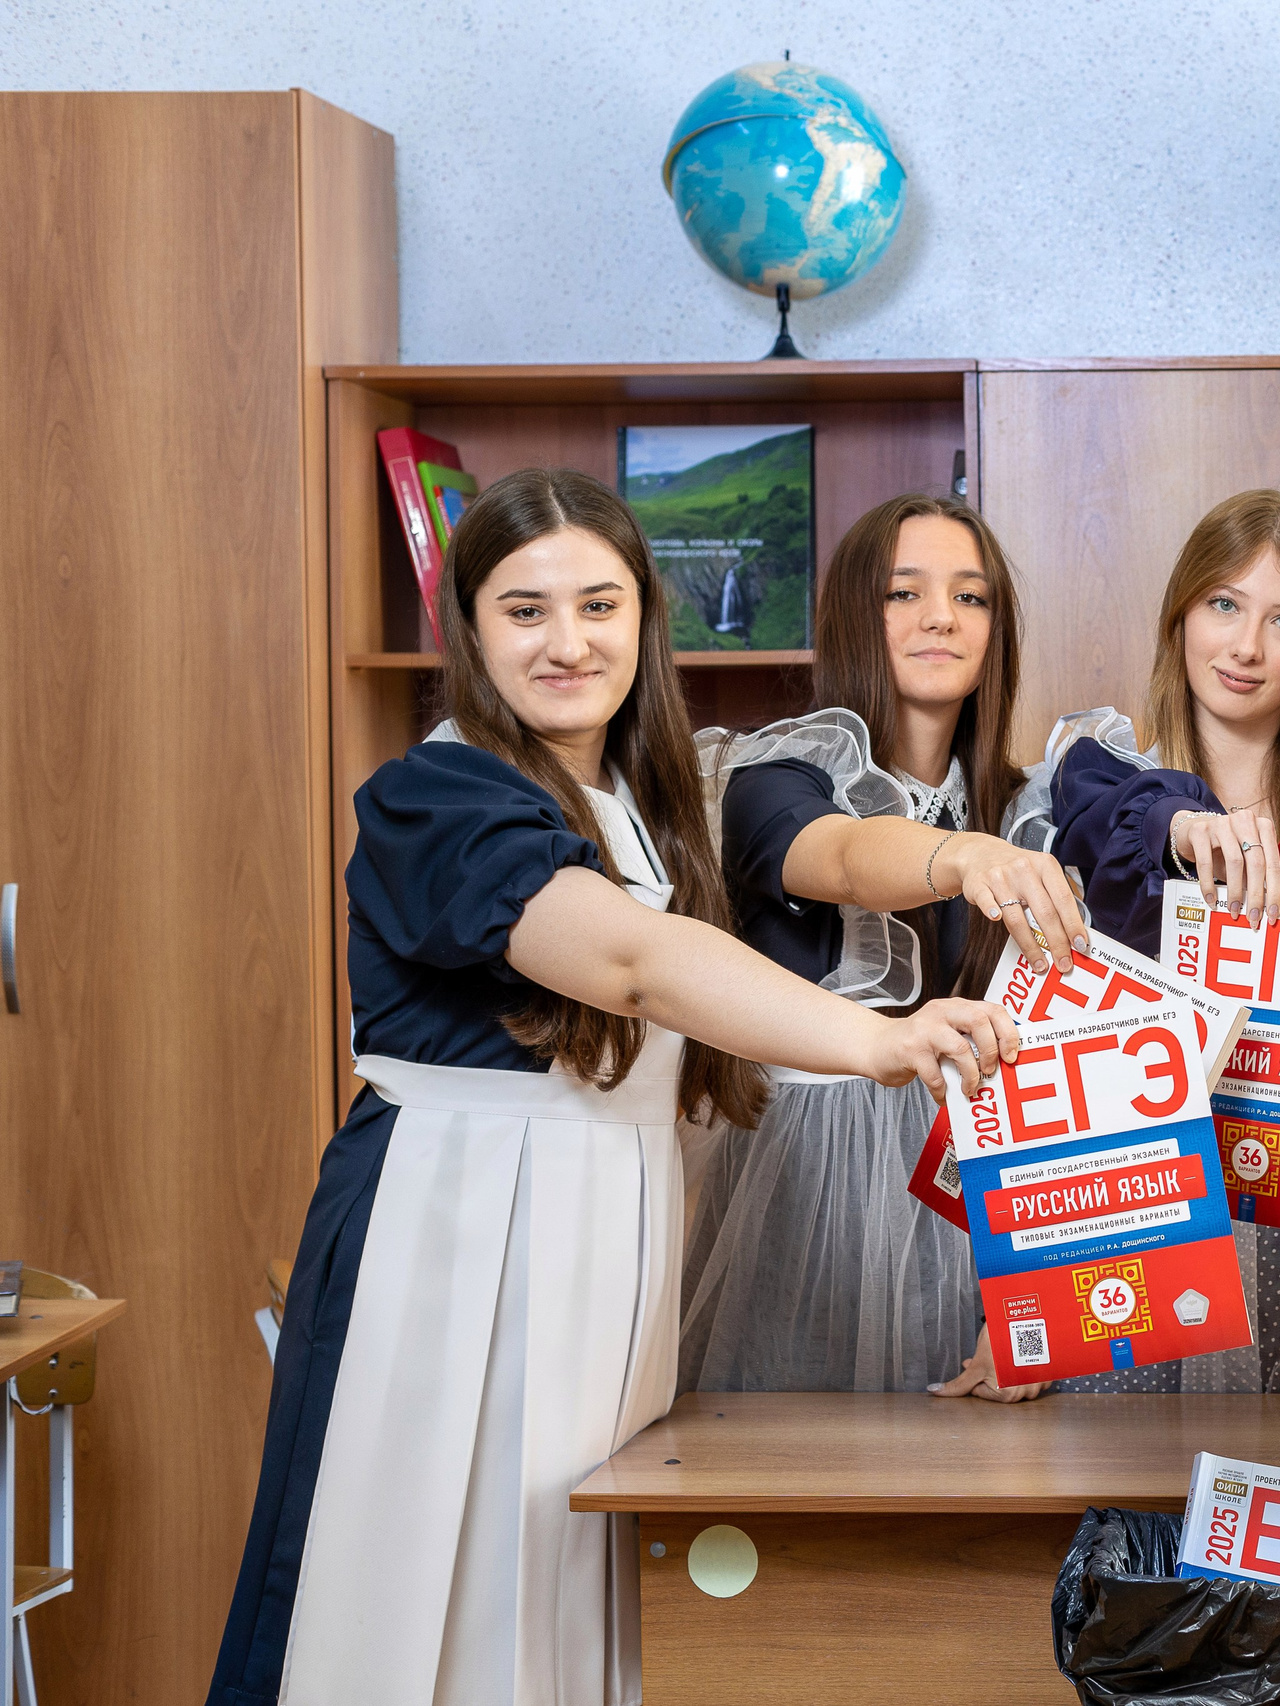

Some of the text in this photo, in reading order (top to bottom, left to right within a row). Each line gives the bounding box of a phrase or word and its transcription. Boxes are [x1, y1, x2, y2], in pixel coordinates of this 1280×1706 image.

[1178, 921, 1201, 930] ШКОЛЕ
[1179, 908, 1203, 920] ФИПИ
[1177, 933, 1200, 982] 025
[1099, 950, 1133, 974] УЧАСТИЕМ
[1207, 1005, 1221, 1017] ЕГЭ
[1028, 1036, 1033, 1044] С
[1036, 1029, 1075, 1044] УЧАСТИЕМ
[1078, 1018, 1140, 1036] РАЗРАБОТЧИКОВ
[1143, 1014, 1160, 1024] КИМ
[1162, 1011, 1177, 1021] ЕГЭ
[1000, 1026, 1189, 1144] ЕГЭ
[969, 1086, 1004, 1149] 2025
[1218, 1102, 1255, 1114] РЕДАКЦИЕЙ
[1010, 1147, 1171, 1183] ЕДИНЫЙ ГОСУДАРСТВЕННЫЙ ЭКЗАМЕН
[1238, 1146, 1262, 1167] 36
[1238, 1166, 1261, 1174] ВАРИАНТОВ
[1011, 1168, 1181, 1222] РУССКИЙ ЯЗЫК
[1020, 1208, 1181, 1244] ТИПОВЫЕ ЭКЗАМЕНАЦИОННЫЕ ВАРИАНТЫ
[1043, 1253, 1059, 1262] ПОД
[1060, 1244, 1105, 1260] РЕДАКЦИЕЙ
[1121, 1234, 1166, 1249] ДОЩИНСКОГО
[1008, 1298, 1036, 1308] включи
[1098, 1286, 1127, 1309] 36
[1009, 1305, 1038, 1317] ege.plus
[1101, 1307, 1129, 1317] ВАРИАНТОВ
[1215, 1493, 1242, 1505] ШКОЛЕ
[1216, 1481, 1245, 1495] ФИПИ
[1205, 1505, 1239, 1566] 2025
